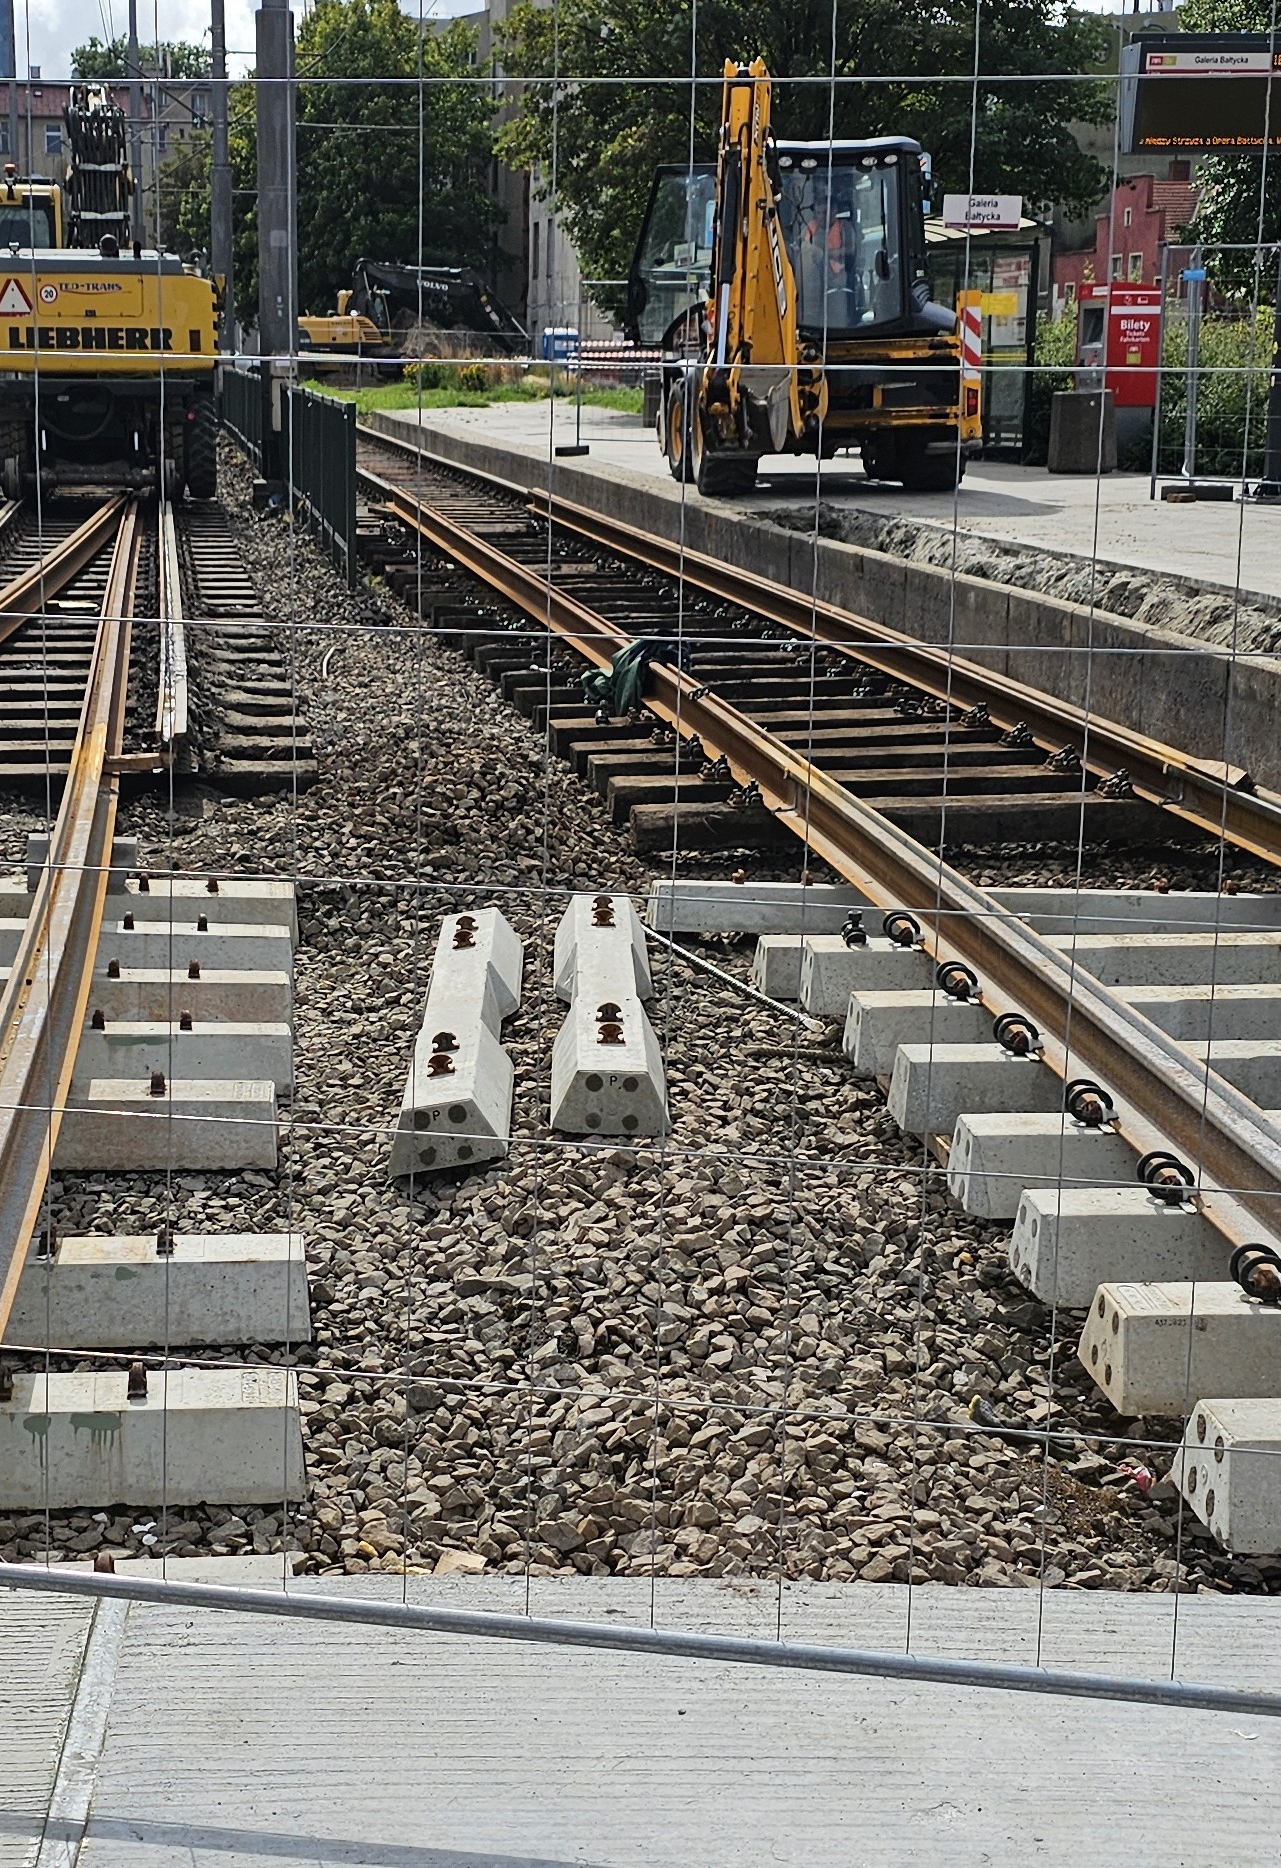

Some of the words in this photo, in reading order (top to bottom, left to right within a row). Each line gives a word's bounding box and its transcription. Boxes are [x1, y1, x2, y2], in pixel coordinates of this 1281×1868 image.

[1194, 55, 1219, 64] Galeria
[1220, 55, 1249, 65] Bałtycka
[968, 198, 999, 208] Galeria
[964, 211, 1001, 224] Bałtycka
[416, 279, 449, 291] VOLVO
[44, 289, 54, 298] 20
[1120, 319, 1151, 333] Bilety
[8, 326, 174, 350] LIEBHERR
